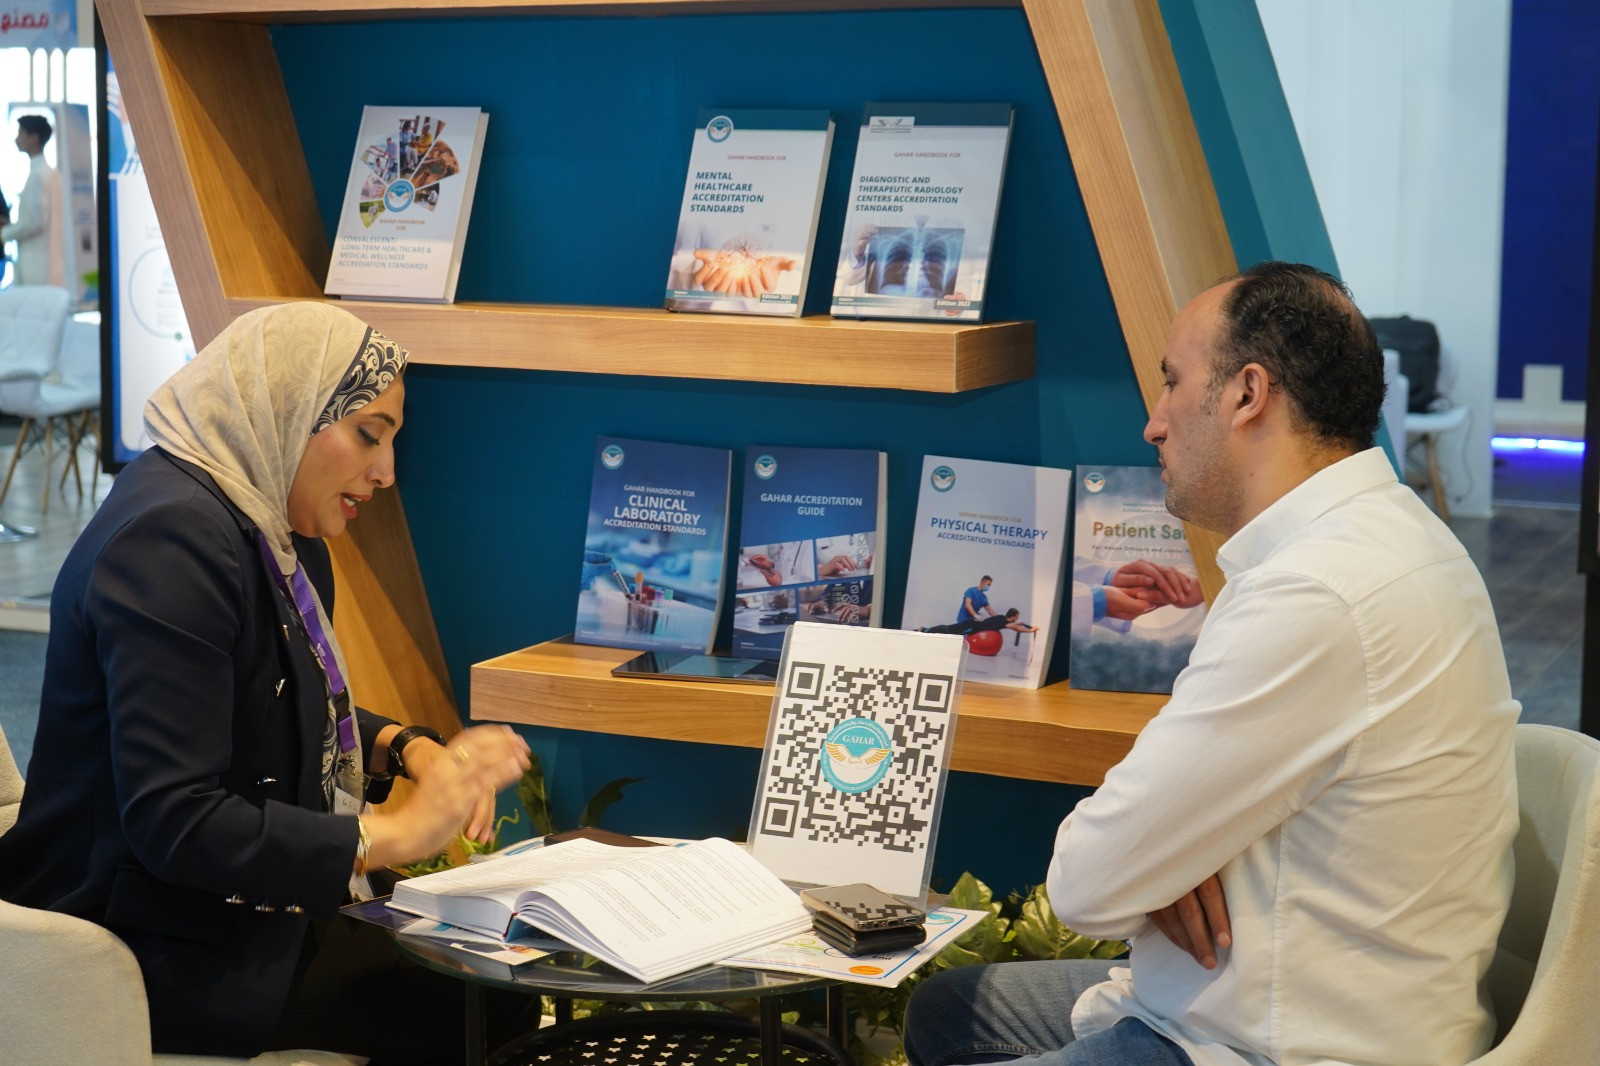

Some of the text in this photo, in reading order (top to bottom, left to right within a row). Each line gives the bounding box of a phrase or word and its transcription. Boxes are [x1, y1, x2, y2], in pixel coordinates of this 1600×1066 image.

[696, 172, 733, 180] MENTAL
[912, 176, 930, 184] AND
[694, 182, 753, 191] HEALTHCARE
[858, 185, 963, 194] THERAPEUTIC RADIOLOGY
[692, 194, 764, 202] ACCREDITATION
[893, 196, 958, 204] ACCREDITATION
[690, 204, 745, 213] STANDARDS
[855, 204, 903, 212] STANDARDS
[382, 245, 425, 253] HEALTHCARE
[370, 253, 405, 261] WELLNESS
[387, 262, 429, 270] STANDARDS
[624, 484, 645, 492] GAHAR
[646, 486, 682, 496] HANDBOOK
[628, 494, 688, 511] CLINICAL
[760, 493, 863, 506] GAHAR ACCREDITATION
[614, 506, 700, 526] LABORATORY
[797, 507, 826, 516] GUIDE
[979, 513, 1009, 521] HANDBOOK
[604, 518, 707, 536] ACCREDITATION STANDARDS
[931, 517, 1048, 540] PHYSICAL THERAPY
[1093, 521, 1156, 538] Patient
[937, 532, 1036, 549] ACCREDITATION STANDARDS
[842, 734, 875, 745] GAHAR
